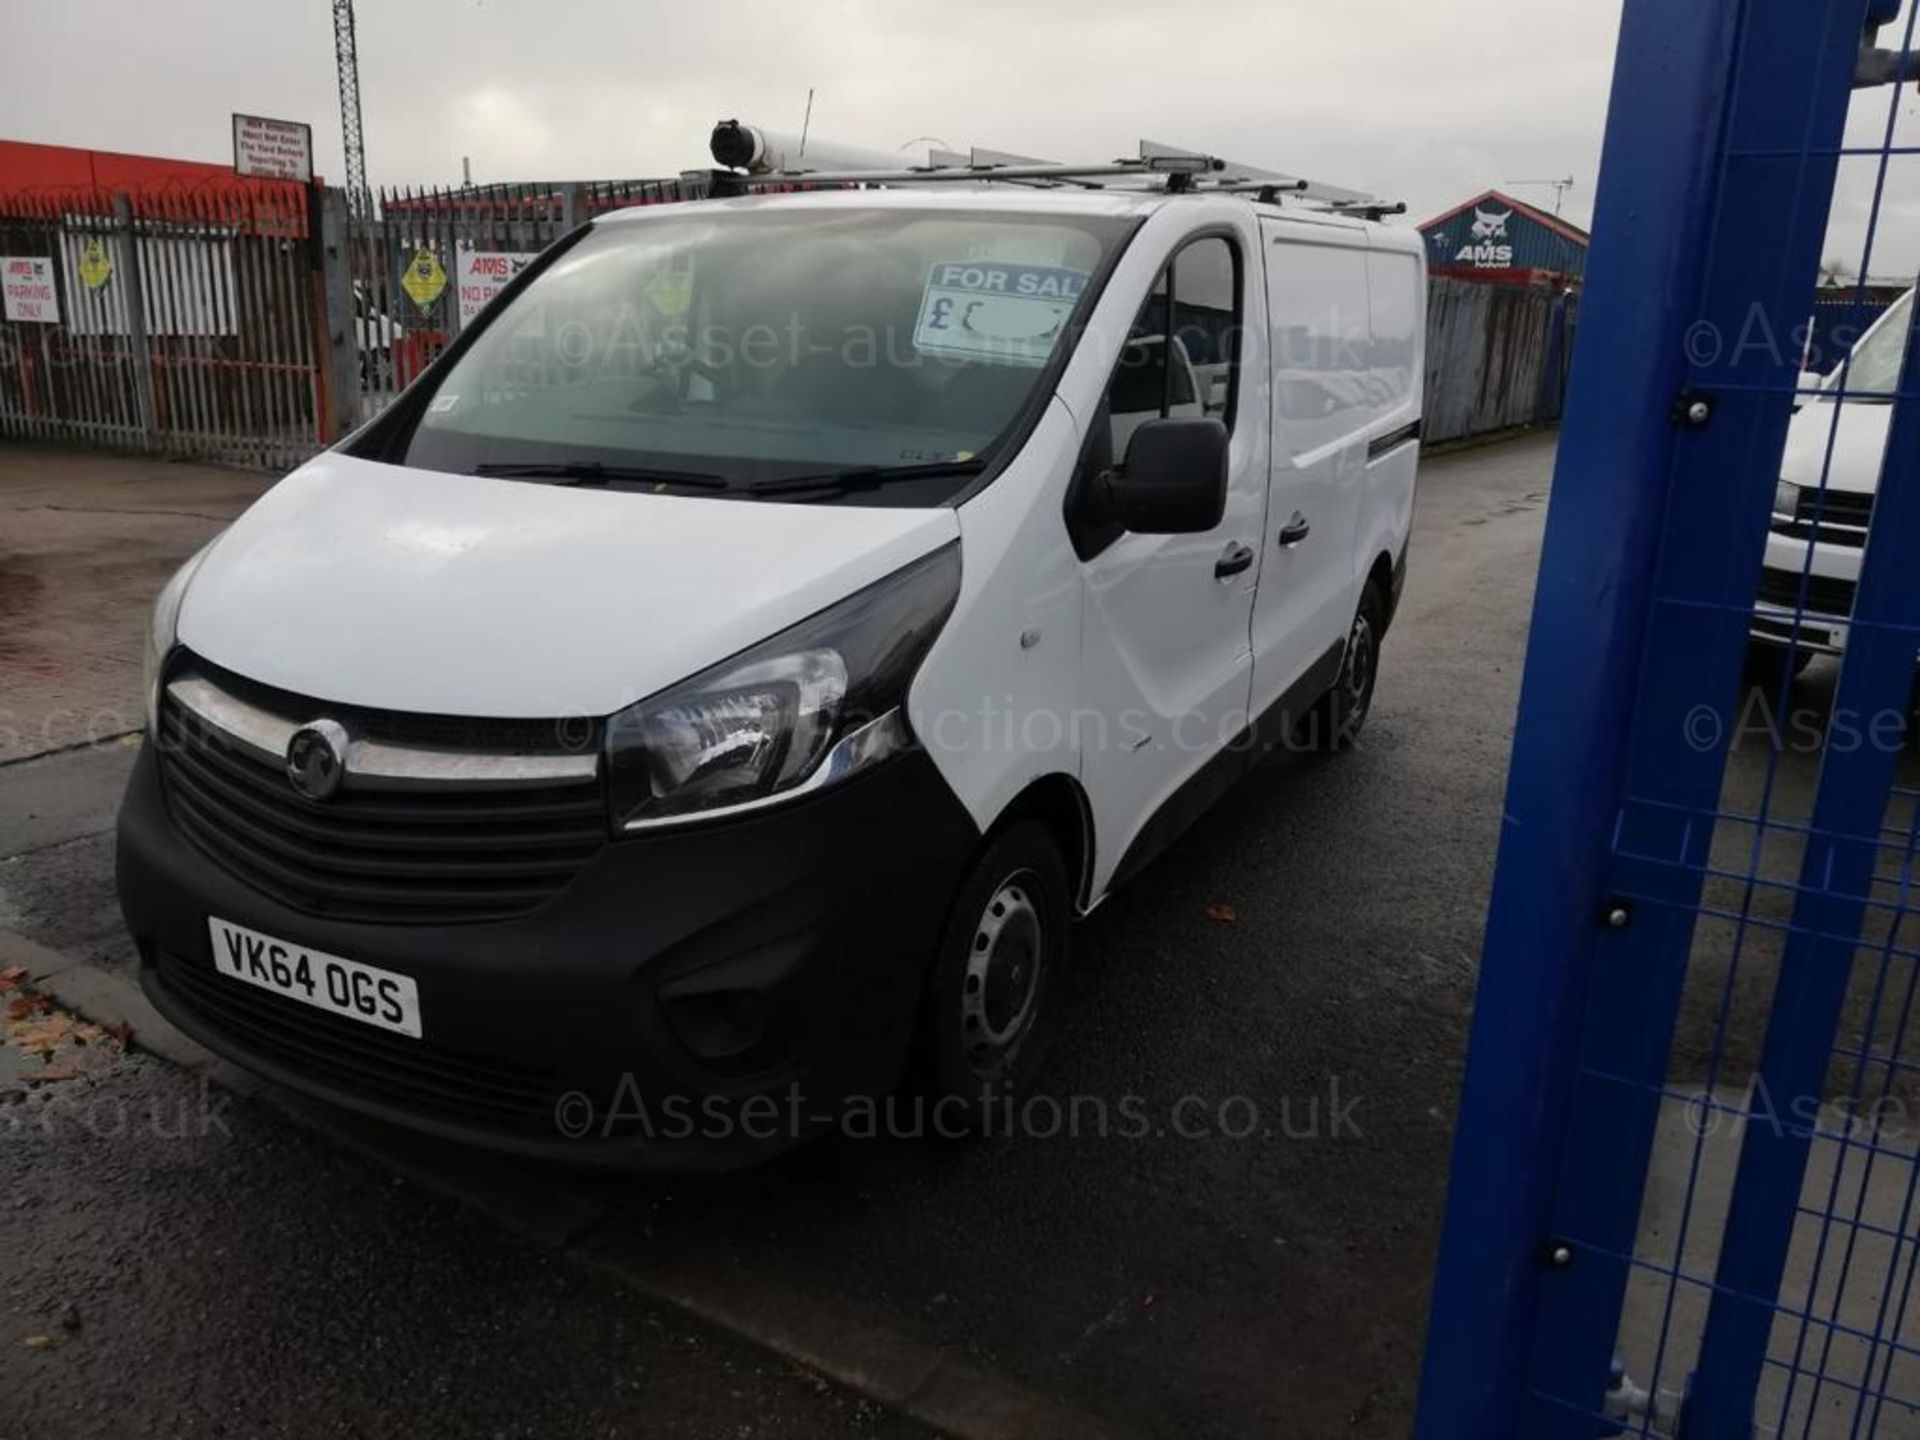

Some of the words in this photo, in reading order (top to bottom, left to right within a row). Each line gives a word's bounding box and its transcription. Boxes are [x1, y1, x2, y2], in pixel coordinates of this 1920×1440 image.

[1455, 245, 1513, 261] AMS
[470, 258, 509, 276] AMS
[941, 266, 1008, 290] FOR
[1016, 273, 1083, 299] SAL
[7, 284, 53, 301] PARKING
[461, 286, 481, 302] NO
[224, 928, 316, 997] VK64
[326, 963, 404, 1024] OGS
